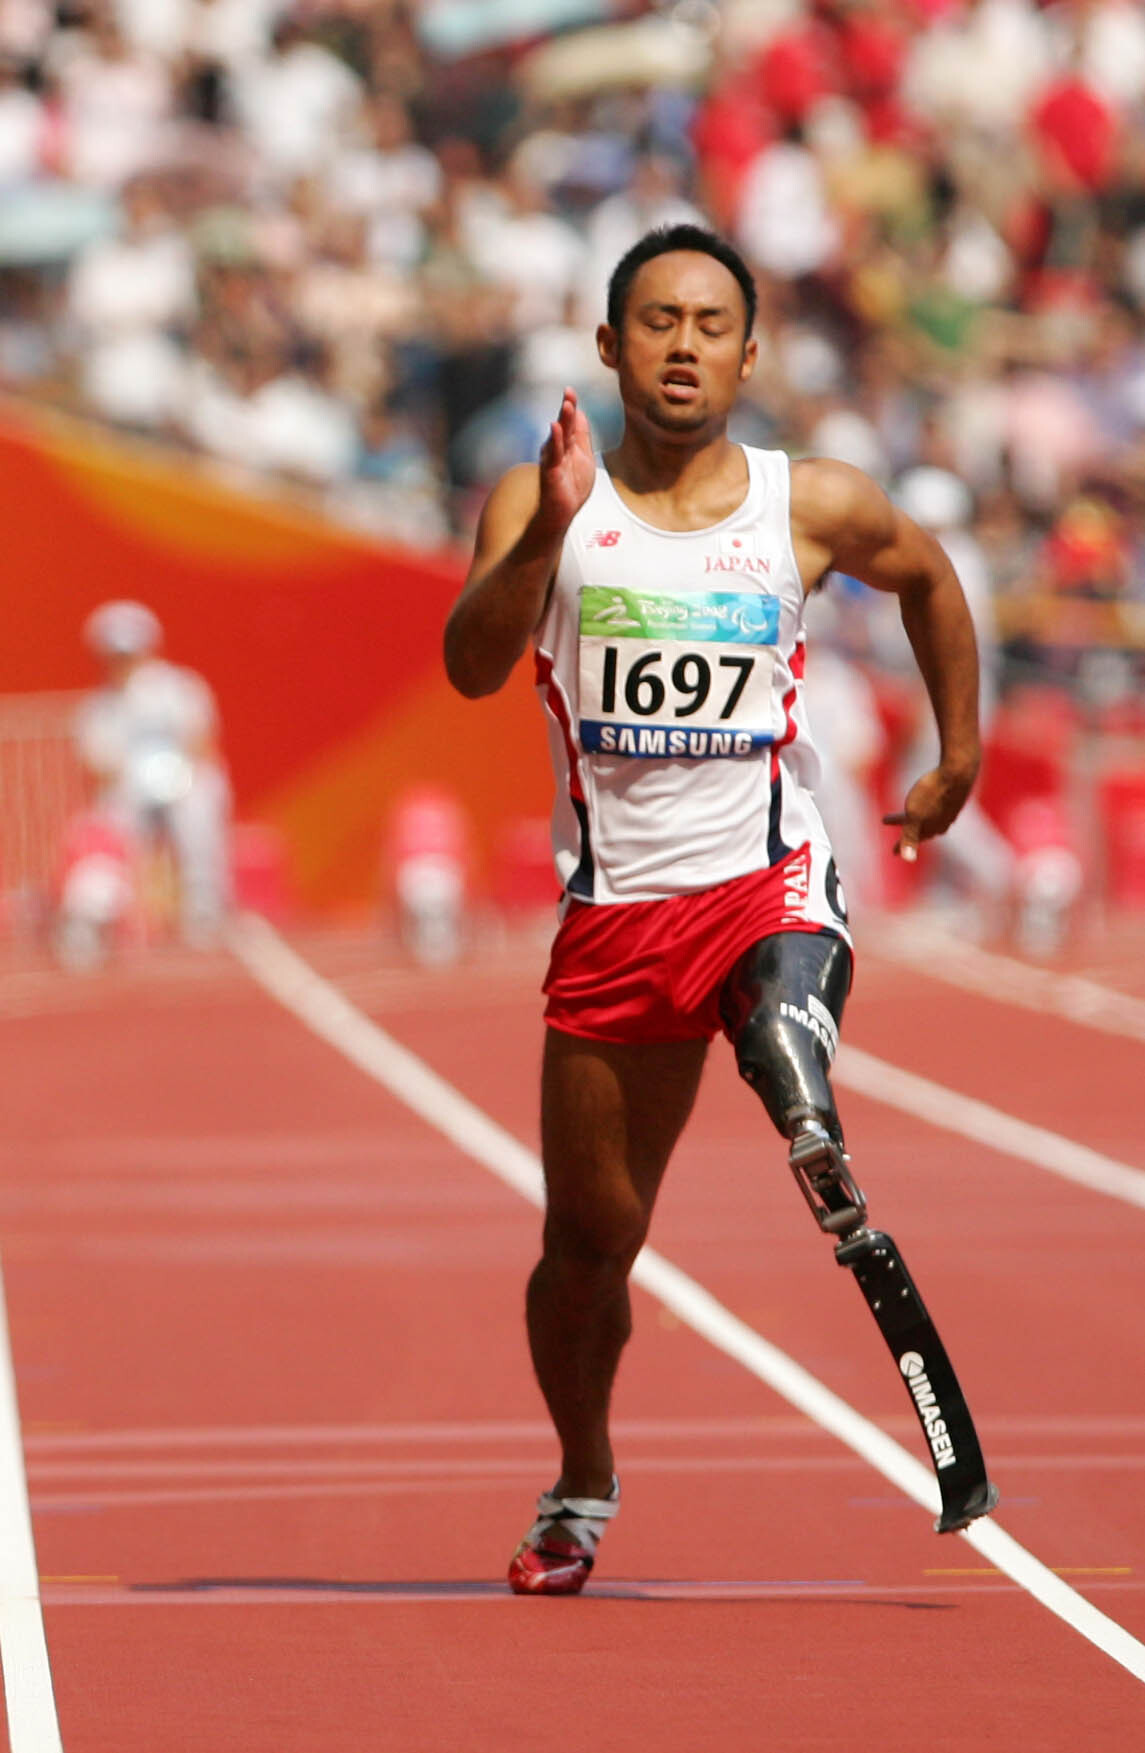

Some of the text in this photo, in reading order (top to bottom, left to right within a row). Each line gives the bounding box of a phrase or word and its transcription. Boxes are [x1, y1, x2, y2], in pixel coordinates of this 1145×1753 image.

[704, 556, 771, 574] JAPAN
[601, 645, 755, 720] 1697
[599, 726, 753, 757] SAMSUNG
[908, 1372, 957, 1471] IMASEN
